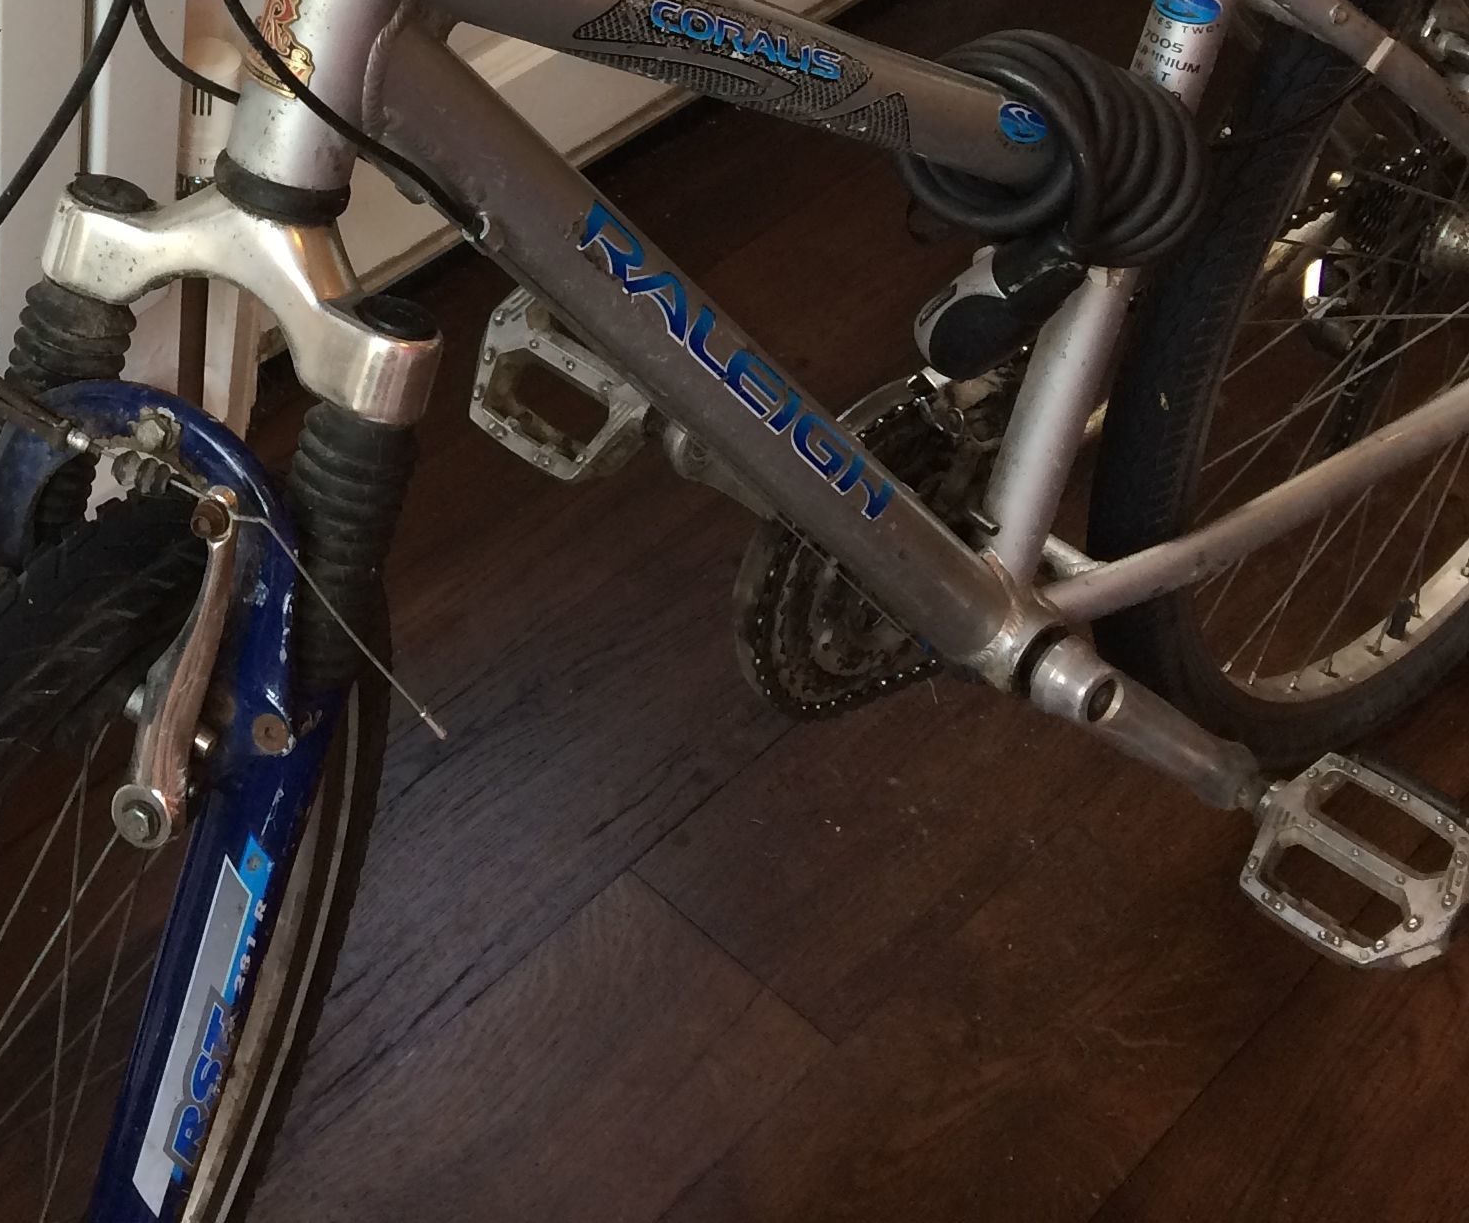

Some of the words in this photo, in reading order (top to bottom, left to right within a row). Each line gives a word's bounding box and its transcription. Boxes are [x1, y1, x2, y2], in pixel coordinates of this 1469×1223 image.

[650, 0, 842, 80] CORALIS
[576, 200, 895, 521] RALEIGH
[172, 1001, 229, 1167] RST
